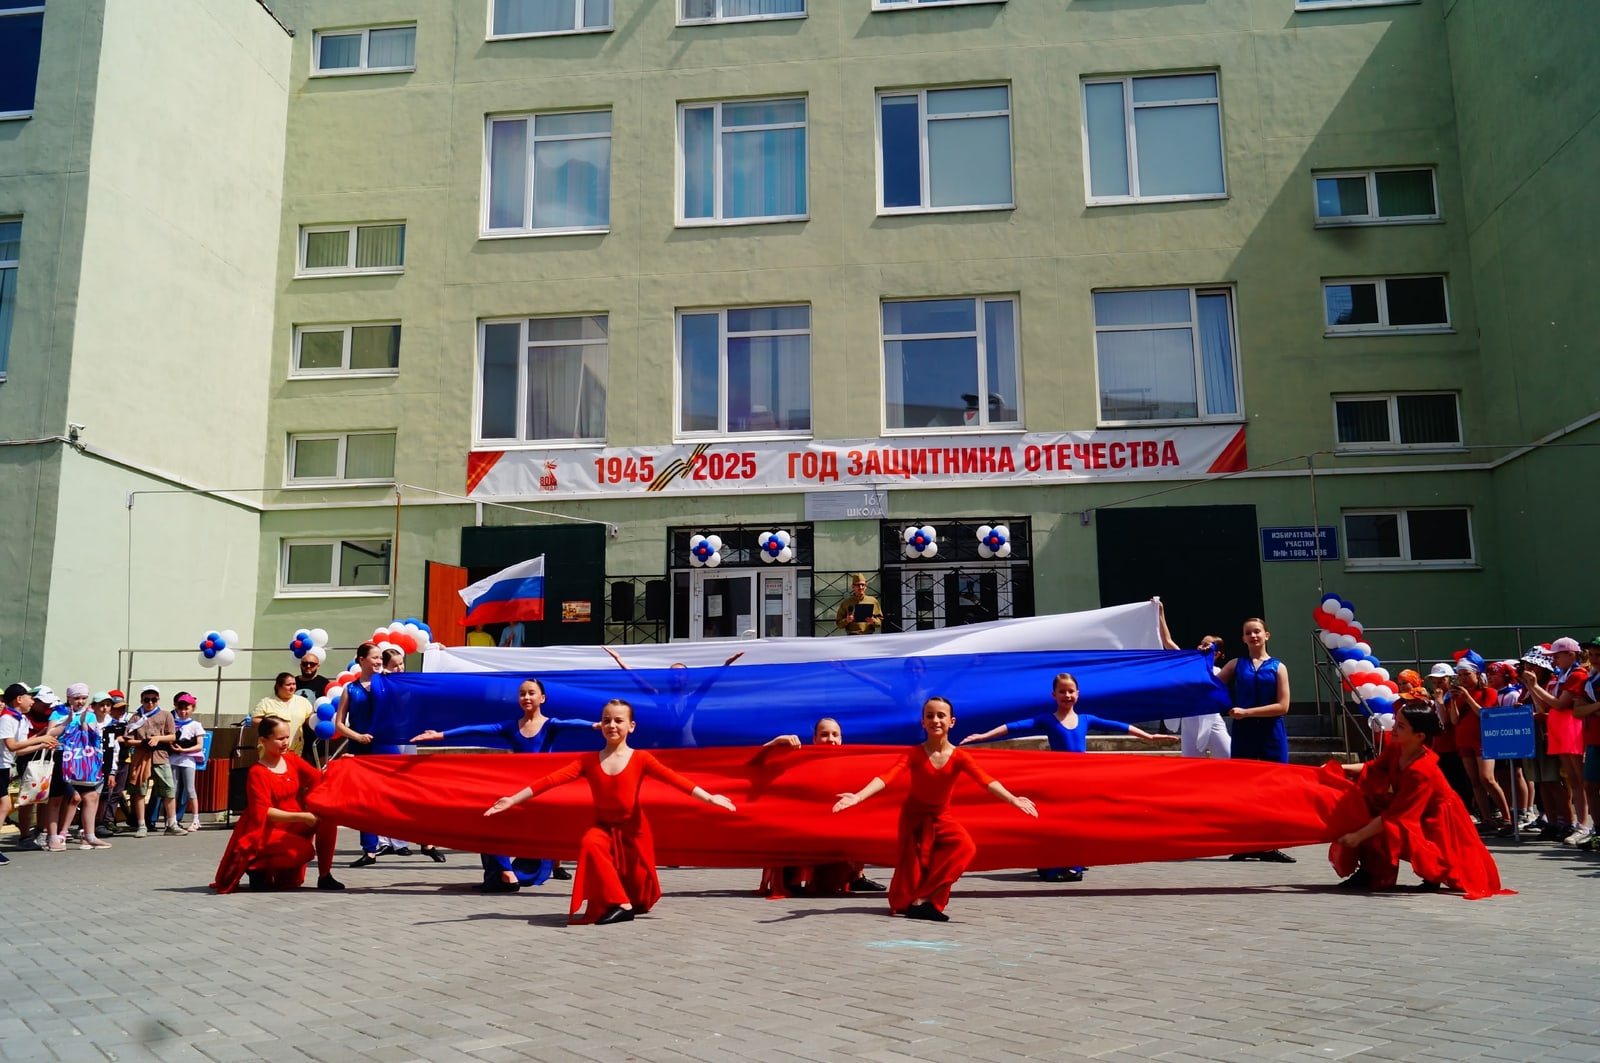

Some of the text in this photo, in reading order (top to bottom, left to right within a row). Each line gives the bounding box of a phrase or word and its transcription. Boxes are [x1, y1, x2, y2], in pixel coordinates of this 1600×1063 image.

[595, 452, 757, 484] 1945 2025
[788, 440, 1180, 482] ГОД ЗАЩИТНИКА ОТЕЧЕСТВА
[847, 507, 886, 517] ШКОЛА
